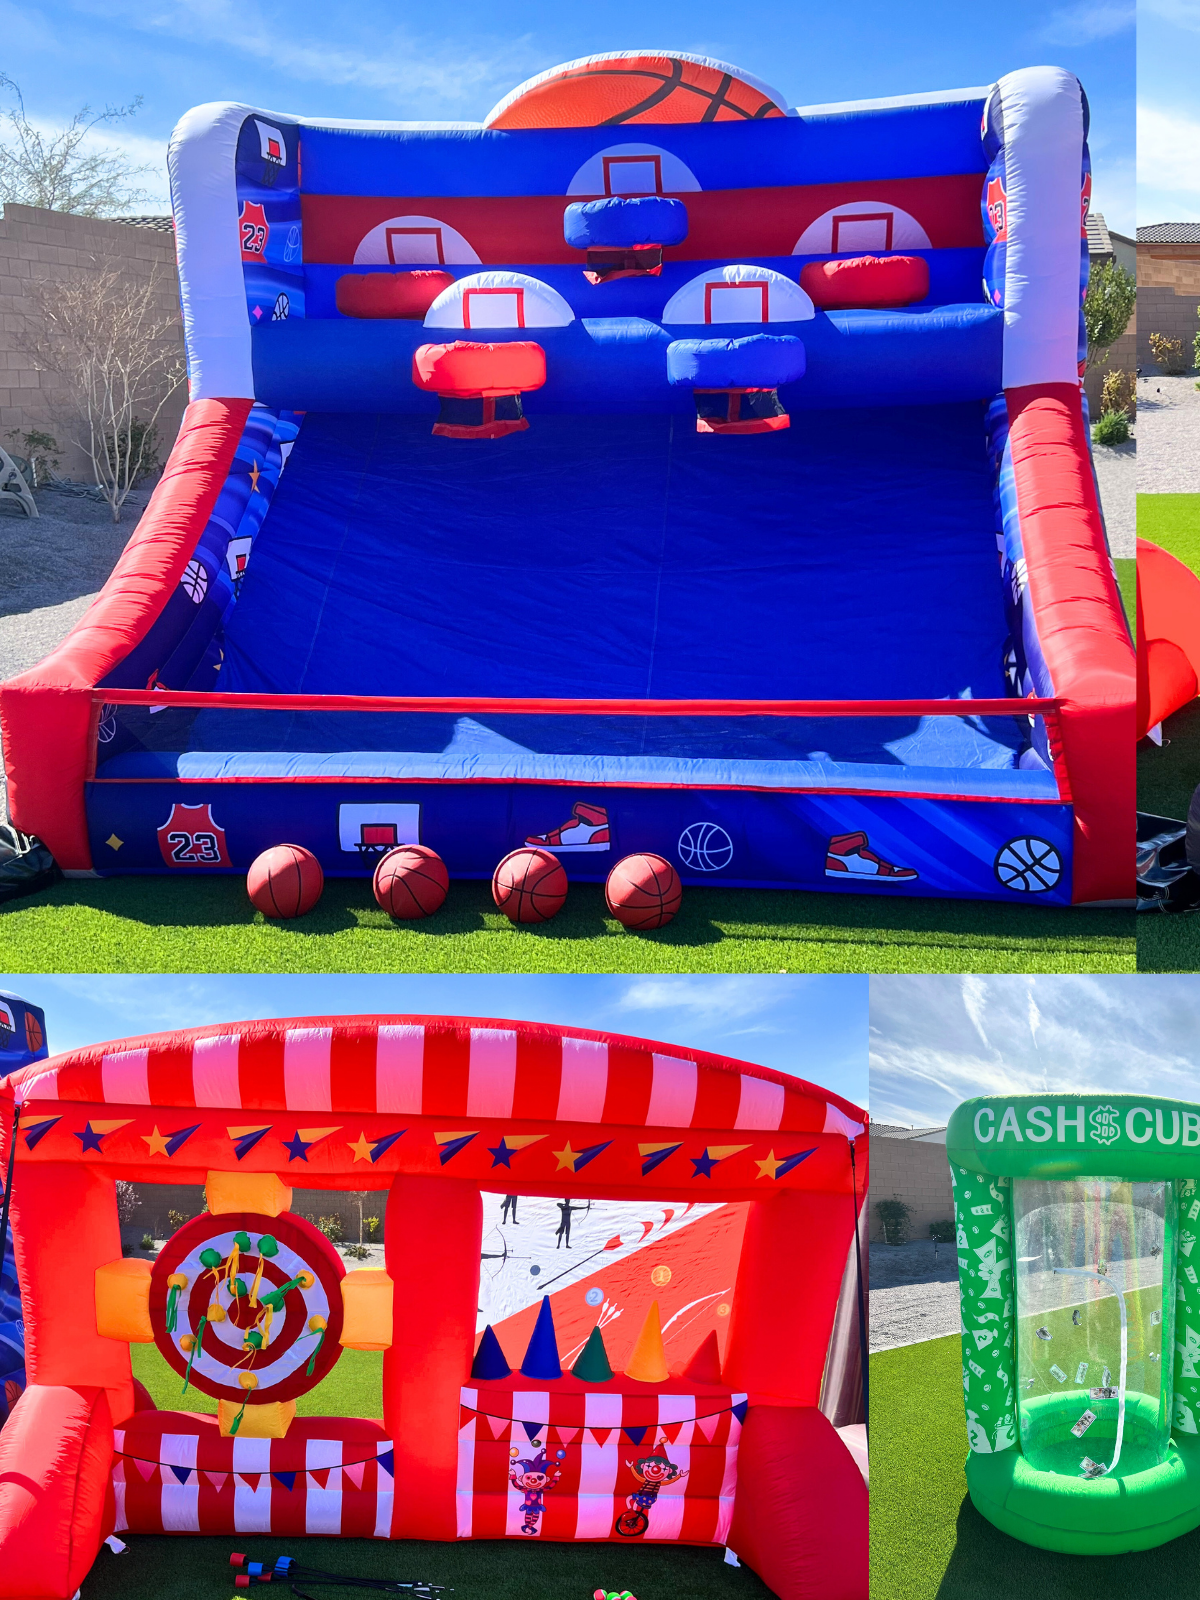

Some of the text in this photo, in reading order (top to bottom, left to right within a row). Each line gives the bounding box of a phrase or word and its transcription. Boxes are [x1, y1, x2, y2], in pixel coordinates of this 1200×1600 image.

[242, 222, 265, 253] 23
[167, 831, 222, 863] 23
[974, 1105, 1086, 1144] CASH
